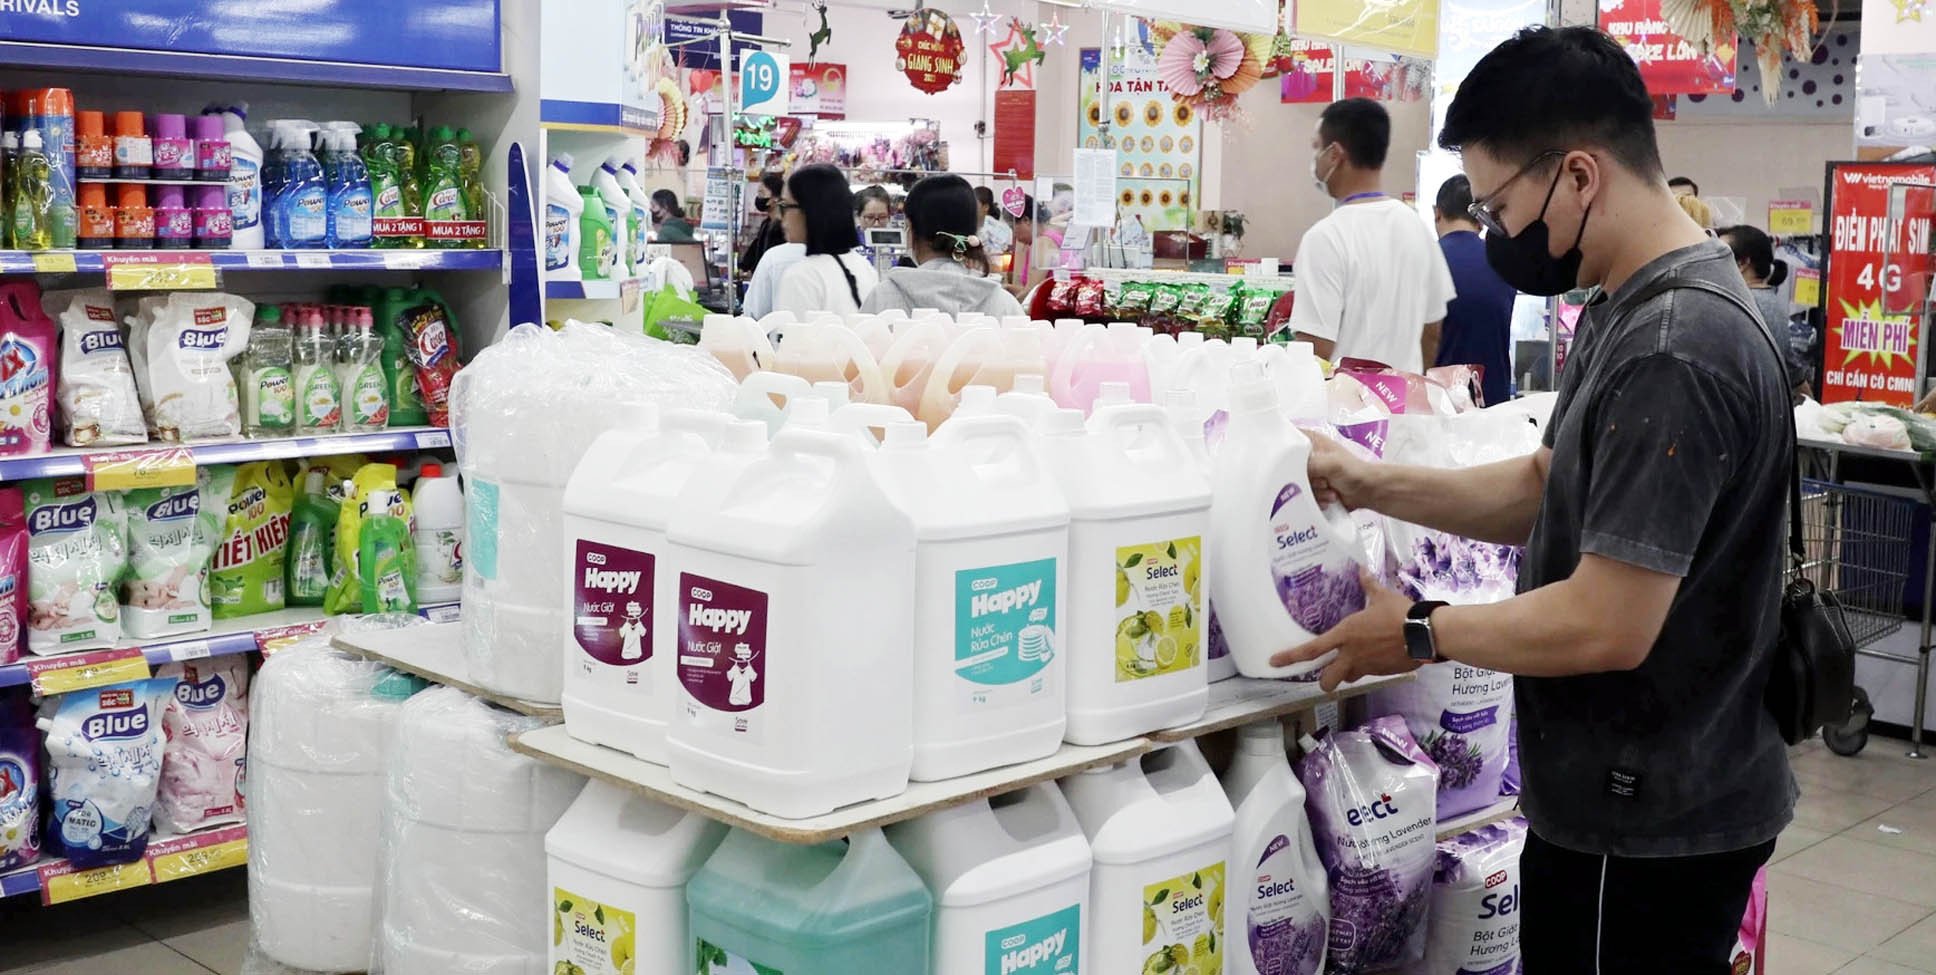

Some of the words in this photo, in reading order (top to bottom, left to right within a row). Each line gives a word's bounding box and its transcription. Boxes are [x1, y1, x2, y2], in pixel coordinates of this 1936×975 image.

[0, 0, 80, 17] RIVALS
[934, 57, 954, 74] SINH
[746, 63, 773, 91] 19
[1863, 173, 1931, 186] vietnamobile
[391, 224, 397, 232] 2
[418, 222, 423, 231] 1
[432, 225, 454, 236] MUA
[454, 226, 461, 235] 2
[1835, 207, 1867, 252] ĐIỂM
[1908, 218, 1931, 255] SIM
[183, 332, 226, 347] Blue
[1841, 310, 1879, 351] MIỄN
[1882, 314, 1911, 354] PHÍ
[260, 377, 290, 390] Power
[1375, 381, 1398, 403] NEW
[154, 497, 200, 518] Blue
[228, 488, 267, 515] Power
[36, 507, 93, 531] Blue
[1277, 525, 1318, 550] Select
[211, 530, 253, 571] TIẾT
[588, 553, 605, 563] COOP
[584, 567, 642, 595] Happy
[1146, 563, 1179, 580] Select
[693, 588, 711, 600] COOP
[973, 579, 996, 590] COOP
[971, 579, 1042, 618] Happy
[688, 603, 752, 635] Happy
[1454, 667, 1474, 681] Bột
[89, 713, 147, 738] Blue
[1389, 816, 1432, 839] Lavender
[1257, 878, 1295, 900] Select
[1485, 872, 1506, 888] COOP
[1172, 893, 1204, 914] Select
[574, 920, 606, 943] Select
[1473, 931, 1495, 943] Bột
[1001, 928, 1067, 975] Happy
